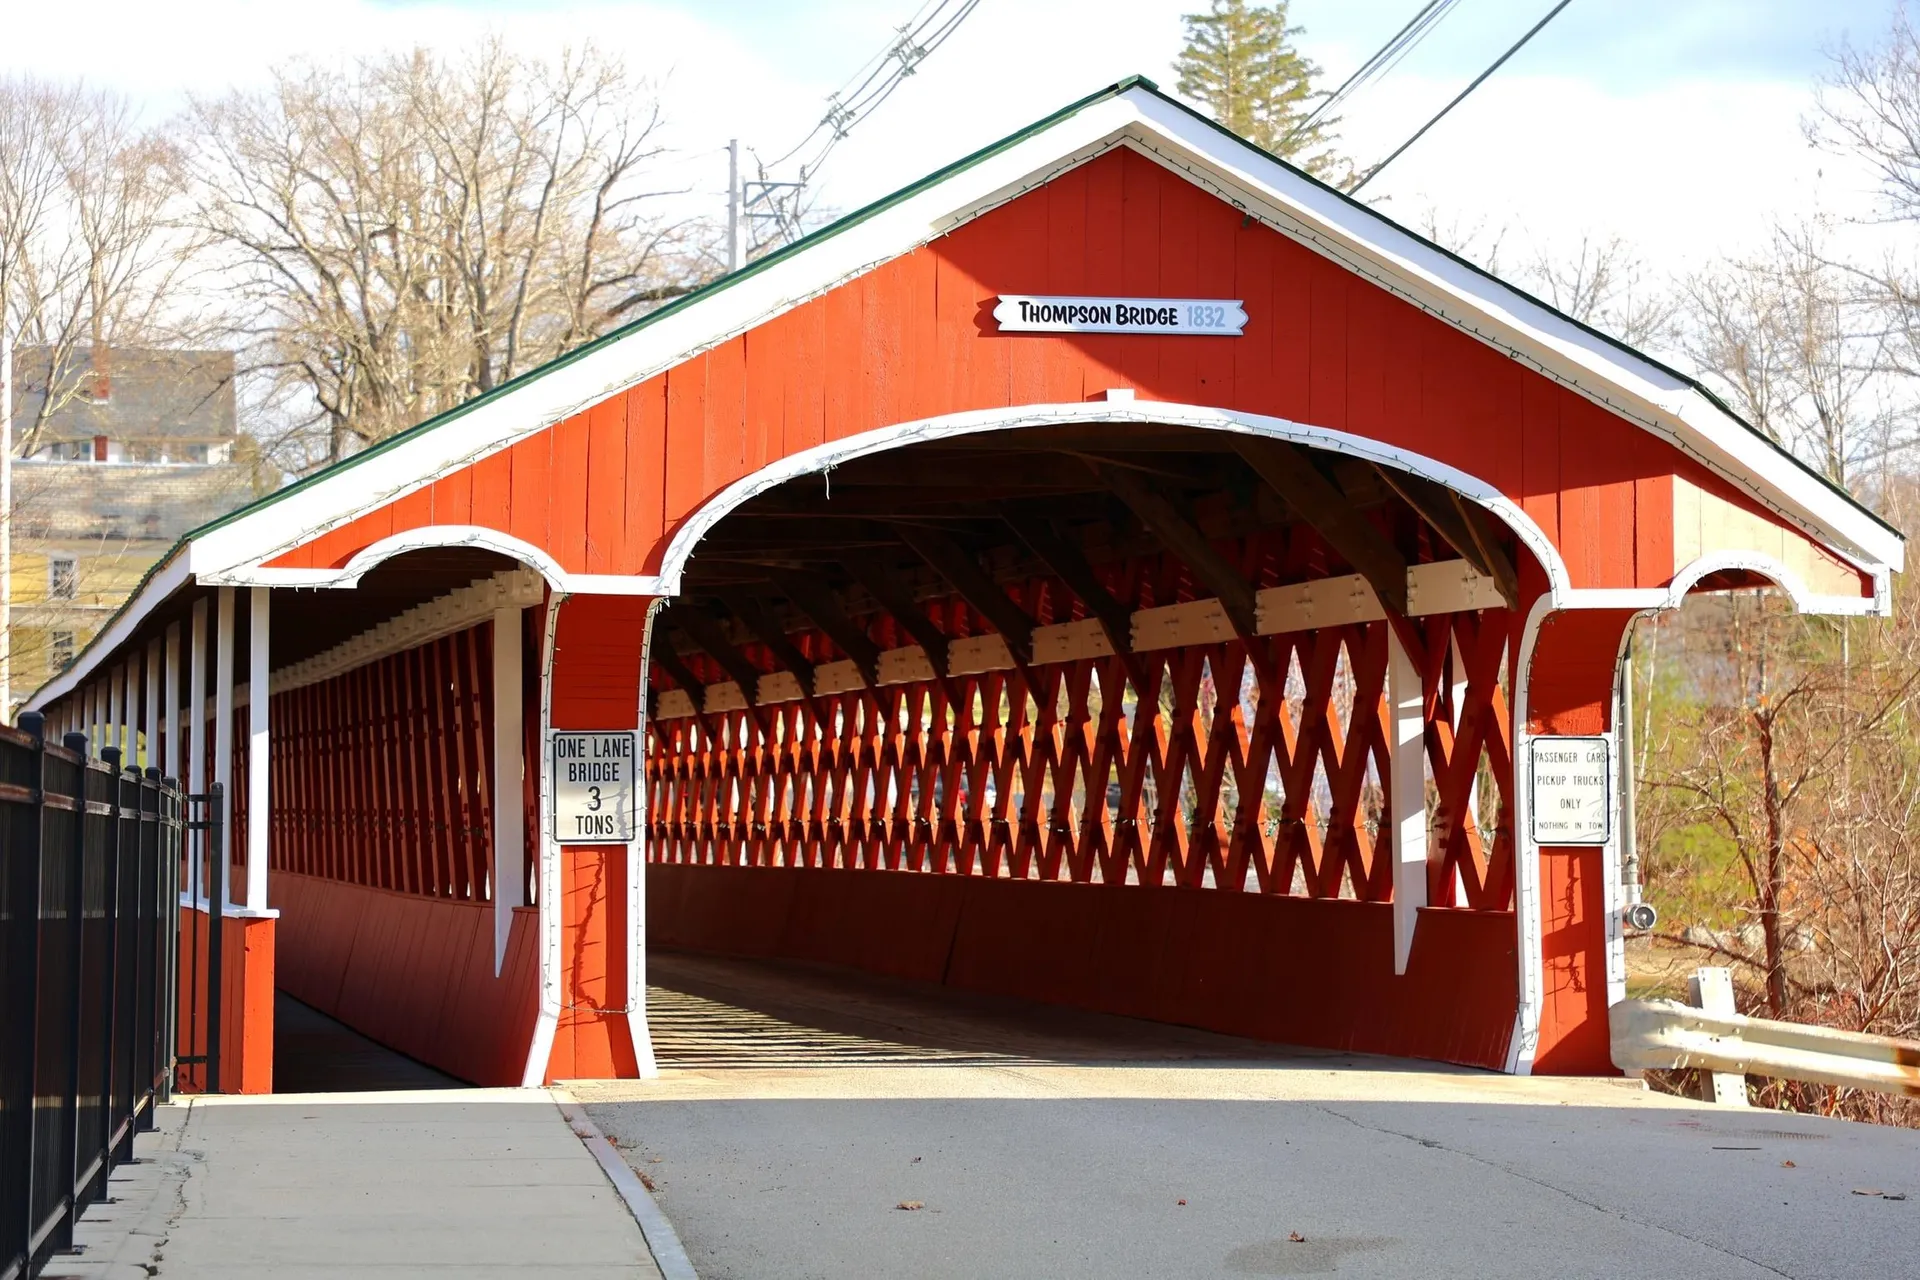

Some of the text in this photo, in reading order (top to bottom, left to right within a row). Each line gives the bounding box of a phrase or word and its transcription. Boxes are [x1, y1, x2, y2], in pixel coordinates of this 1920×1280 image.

[1018, 301, 1226, 328] THOMPSON BRIDGE 1832
[558, 738, 630, 758] ONE LANE
[1535, 752, 1606, 763] PASSENGER CARS
[568, 762, 620, 782] BRIDGE
[1537, 775, 1604, 786] PICKUP TRUCKS
[587, 786, 601, 811] 3
[1560, 798, 1581, 809] ONLY
[575, 815, 614, 835] TONS
[1538, 822, 1603, 830] NOTHING IN TOW
